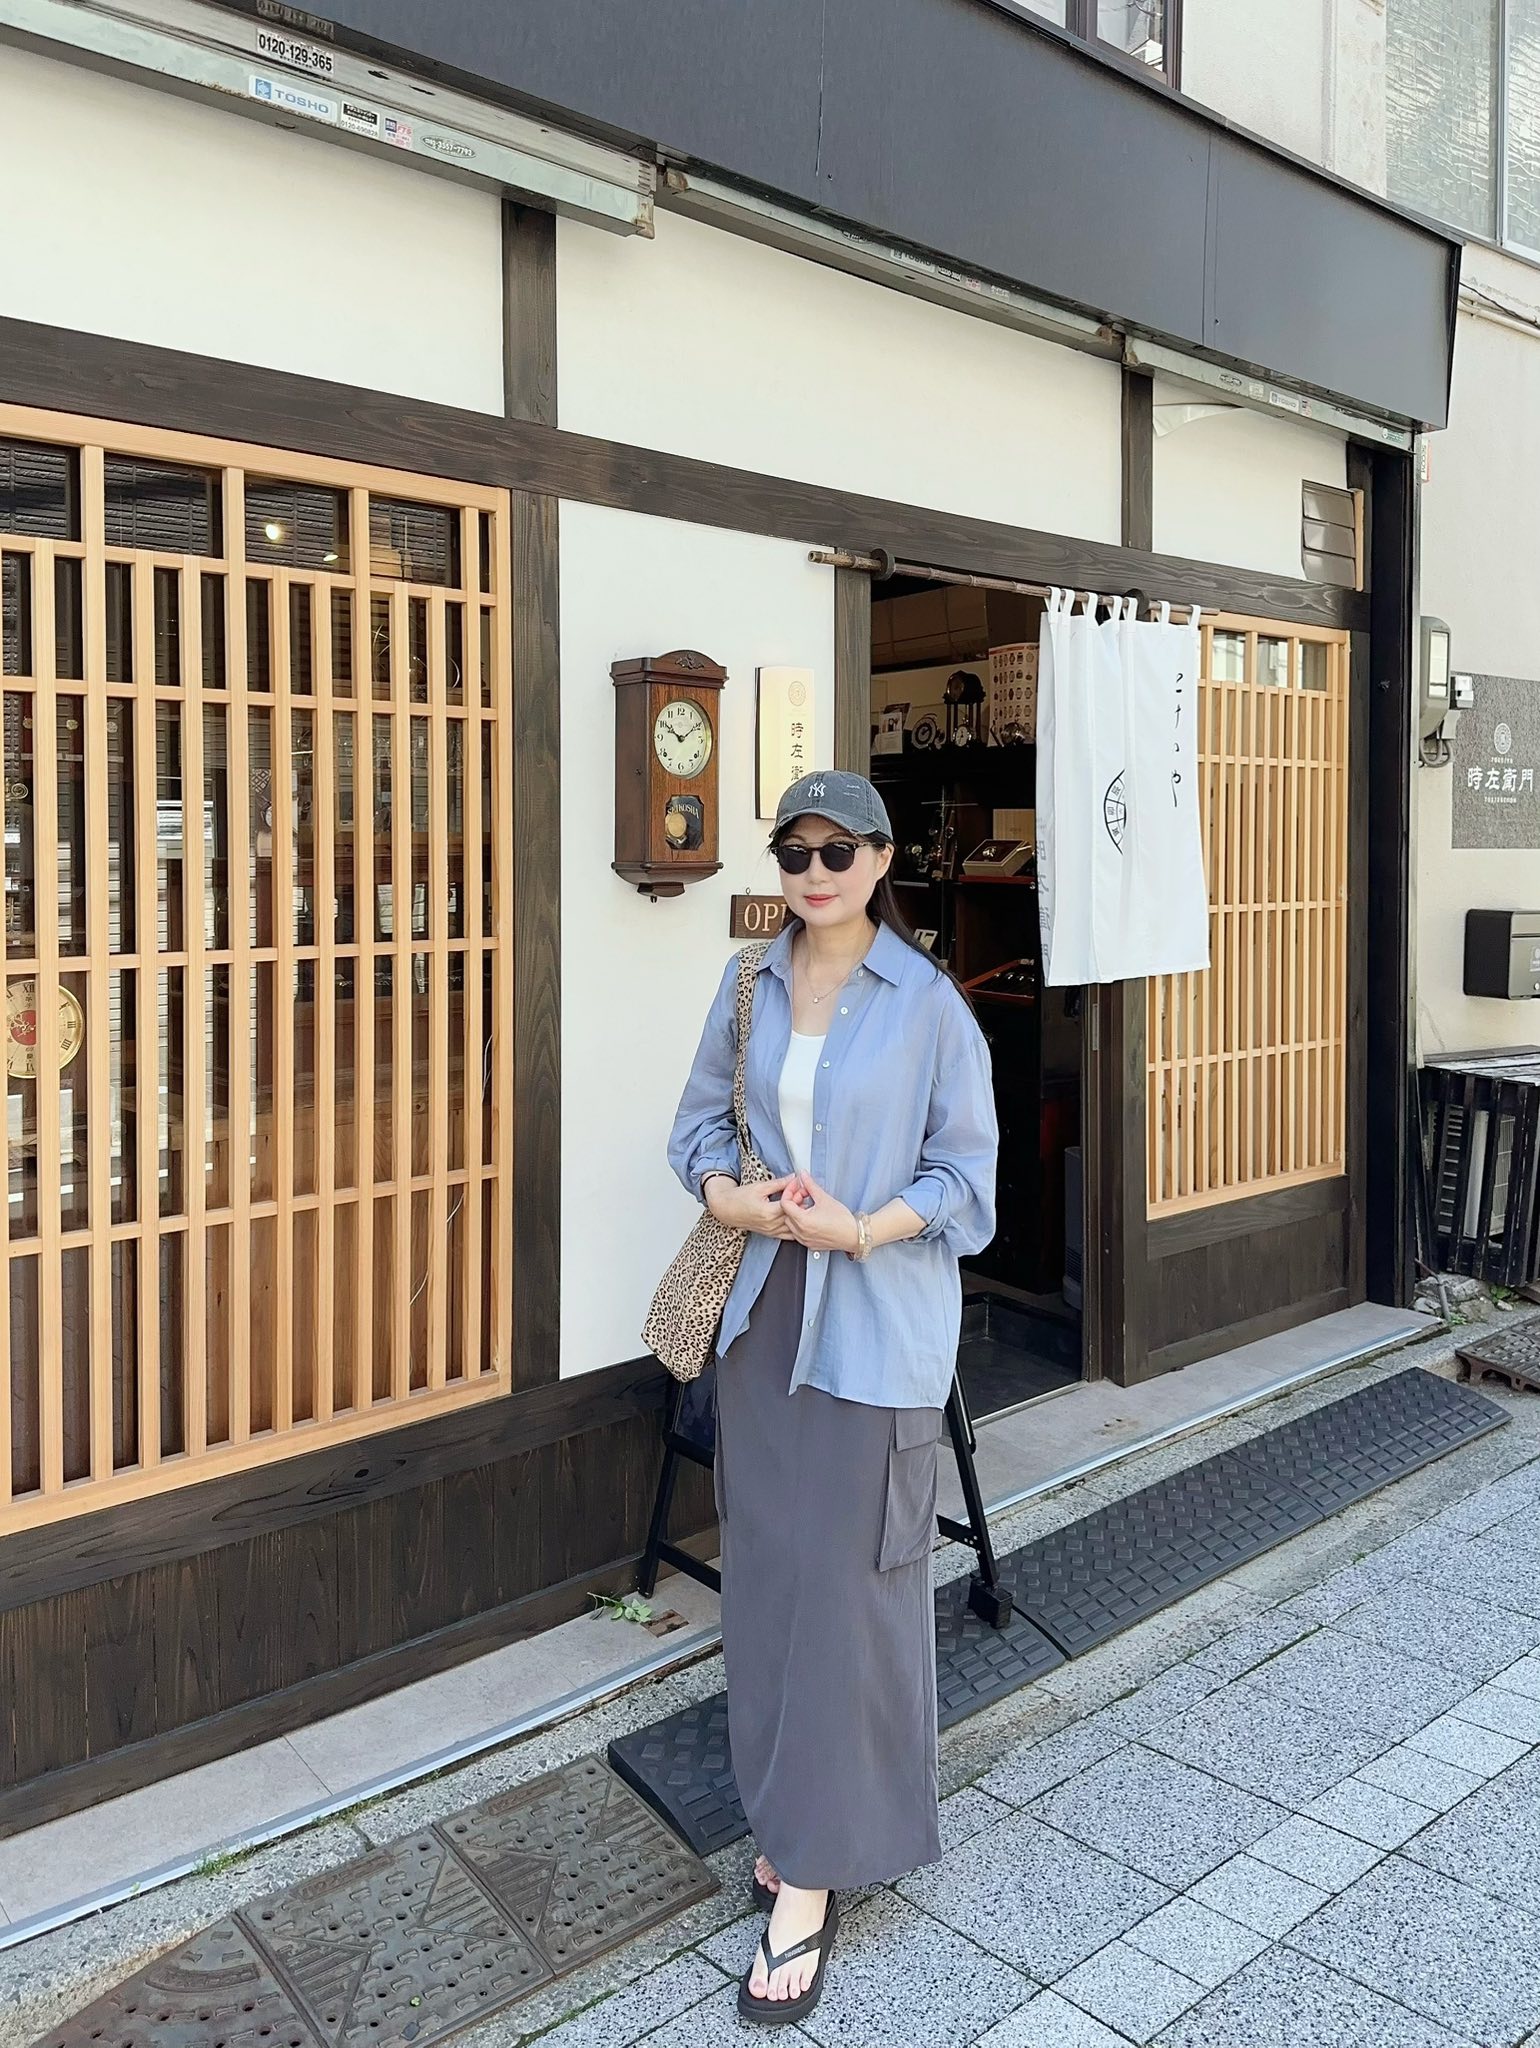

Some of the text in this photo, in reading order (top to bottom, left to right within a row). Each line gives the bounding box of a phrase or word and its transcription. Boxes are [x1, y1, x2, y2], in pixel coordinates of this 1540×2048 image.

[258, 34, 332, 72] 0120-129-365
[274, 88, 329, 114] TOSHO
[808, 782, 826, 798] NY
[1467, 765, 1534, 792] 時左衛門
